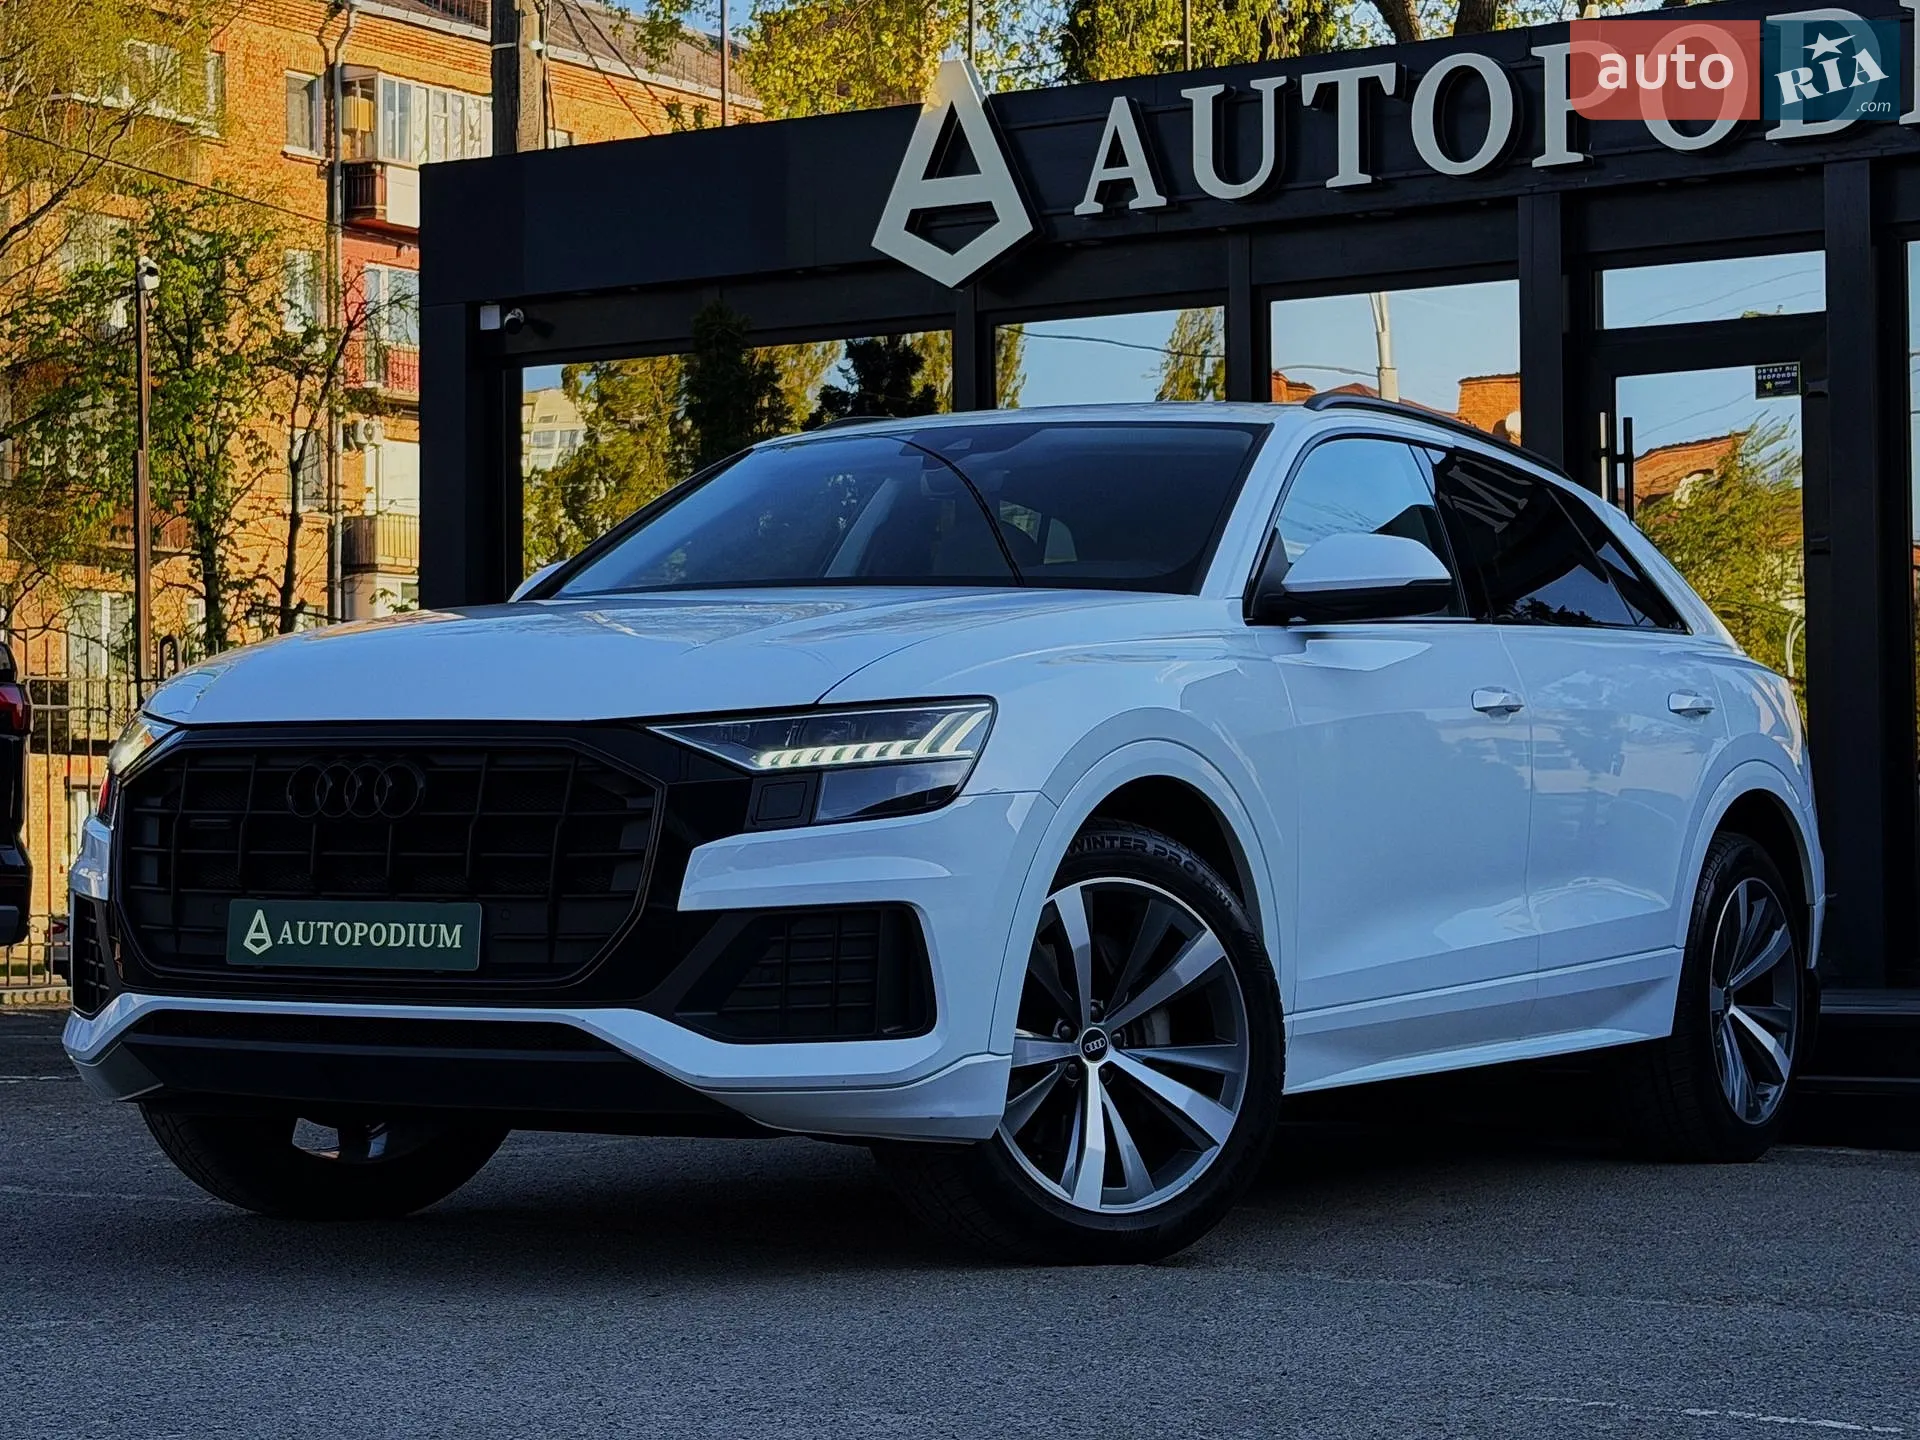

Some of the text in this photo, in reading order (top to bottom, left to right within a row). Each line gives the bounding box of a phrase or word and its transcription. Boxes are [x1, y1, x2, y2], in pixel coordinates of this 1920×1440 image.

[1068, 835, 1149, 855] WINTER
[1152, 844, 1198, 874] PRO
[277, 920, 463, 948] AUTOPODIUM
